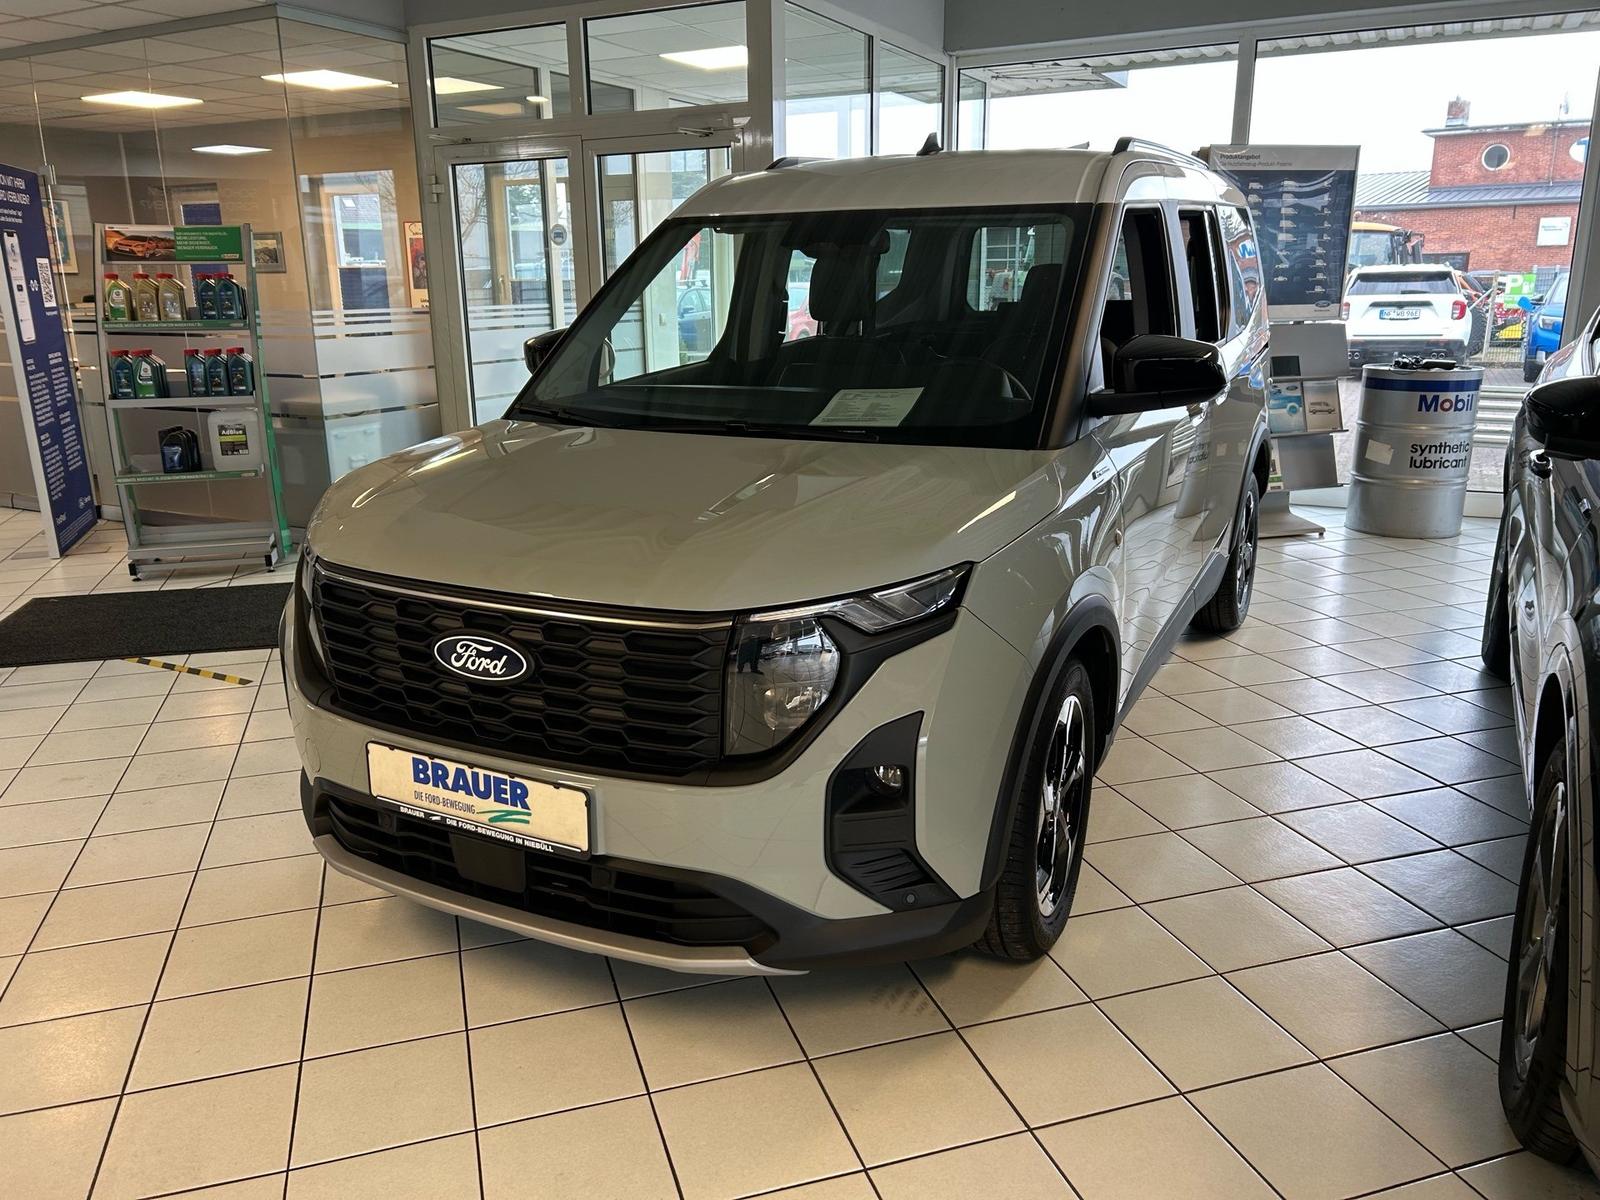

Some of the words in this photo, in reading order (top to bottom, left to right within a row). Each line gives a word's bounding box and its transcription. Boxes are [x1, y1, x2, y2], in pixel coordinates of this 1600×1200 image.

[1417, 393, 1474, 413] Mobil
[1409, 440, 1470, 457] synthetic
[1409, 455, 1467, 470] lubricant
[451, 640, 508, 676] Ford
[412, 756, 531, 811] BRAUER
[414, 790, 425, 802] DIE
[400, 806, 425, 819] BRAUER
[446, 817, 458, 827] DIE
[458, 821, 515, 843] FORD-BEWEGUNG
[515, 837, 523, 845] IN
[524, 839, 554, 852] NIEBÜLL
